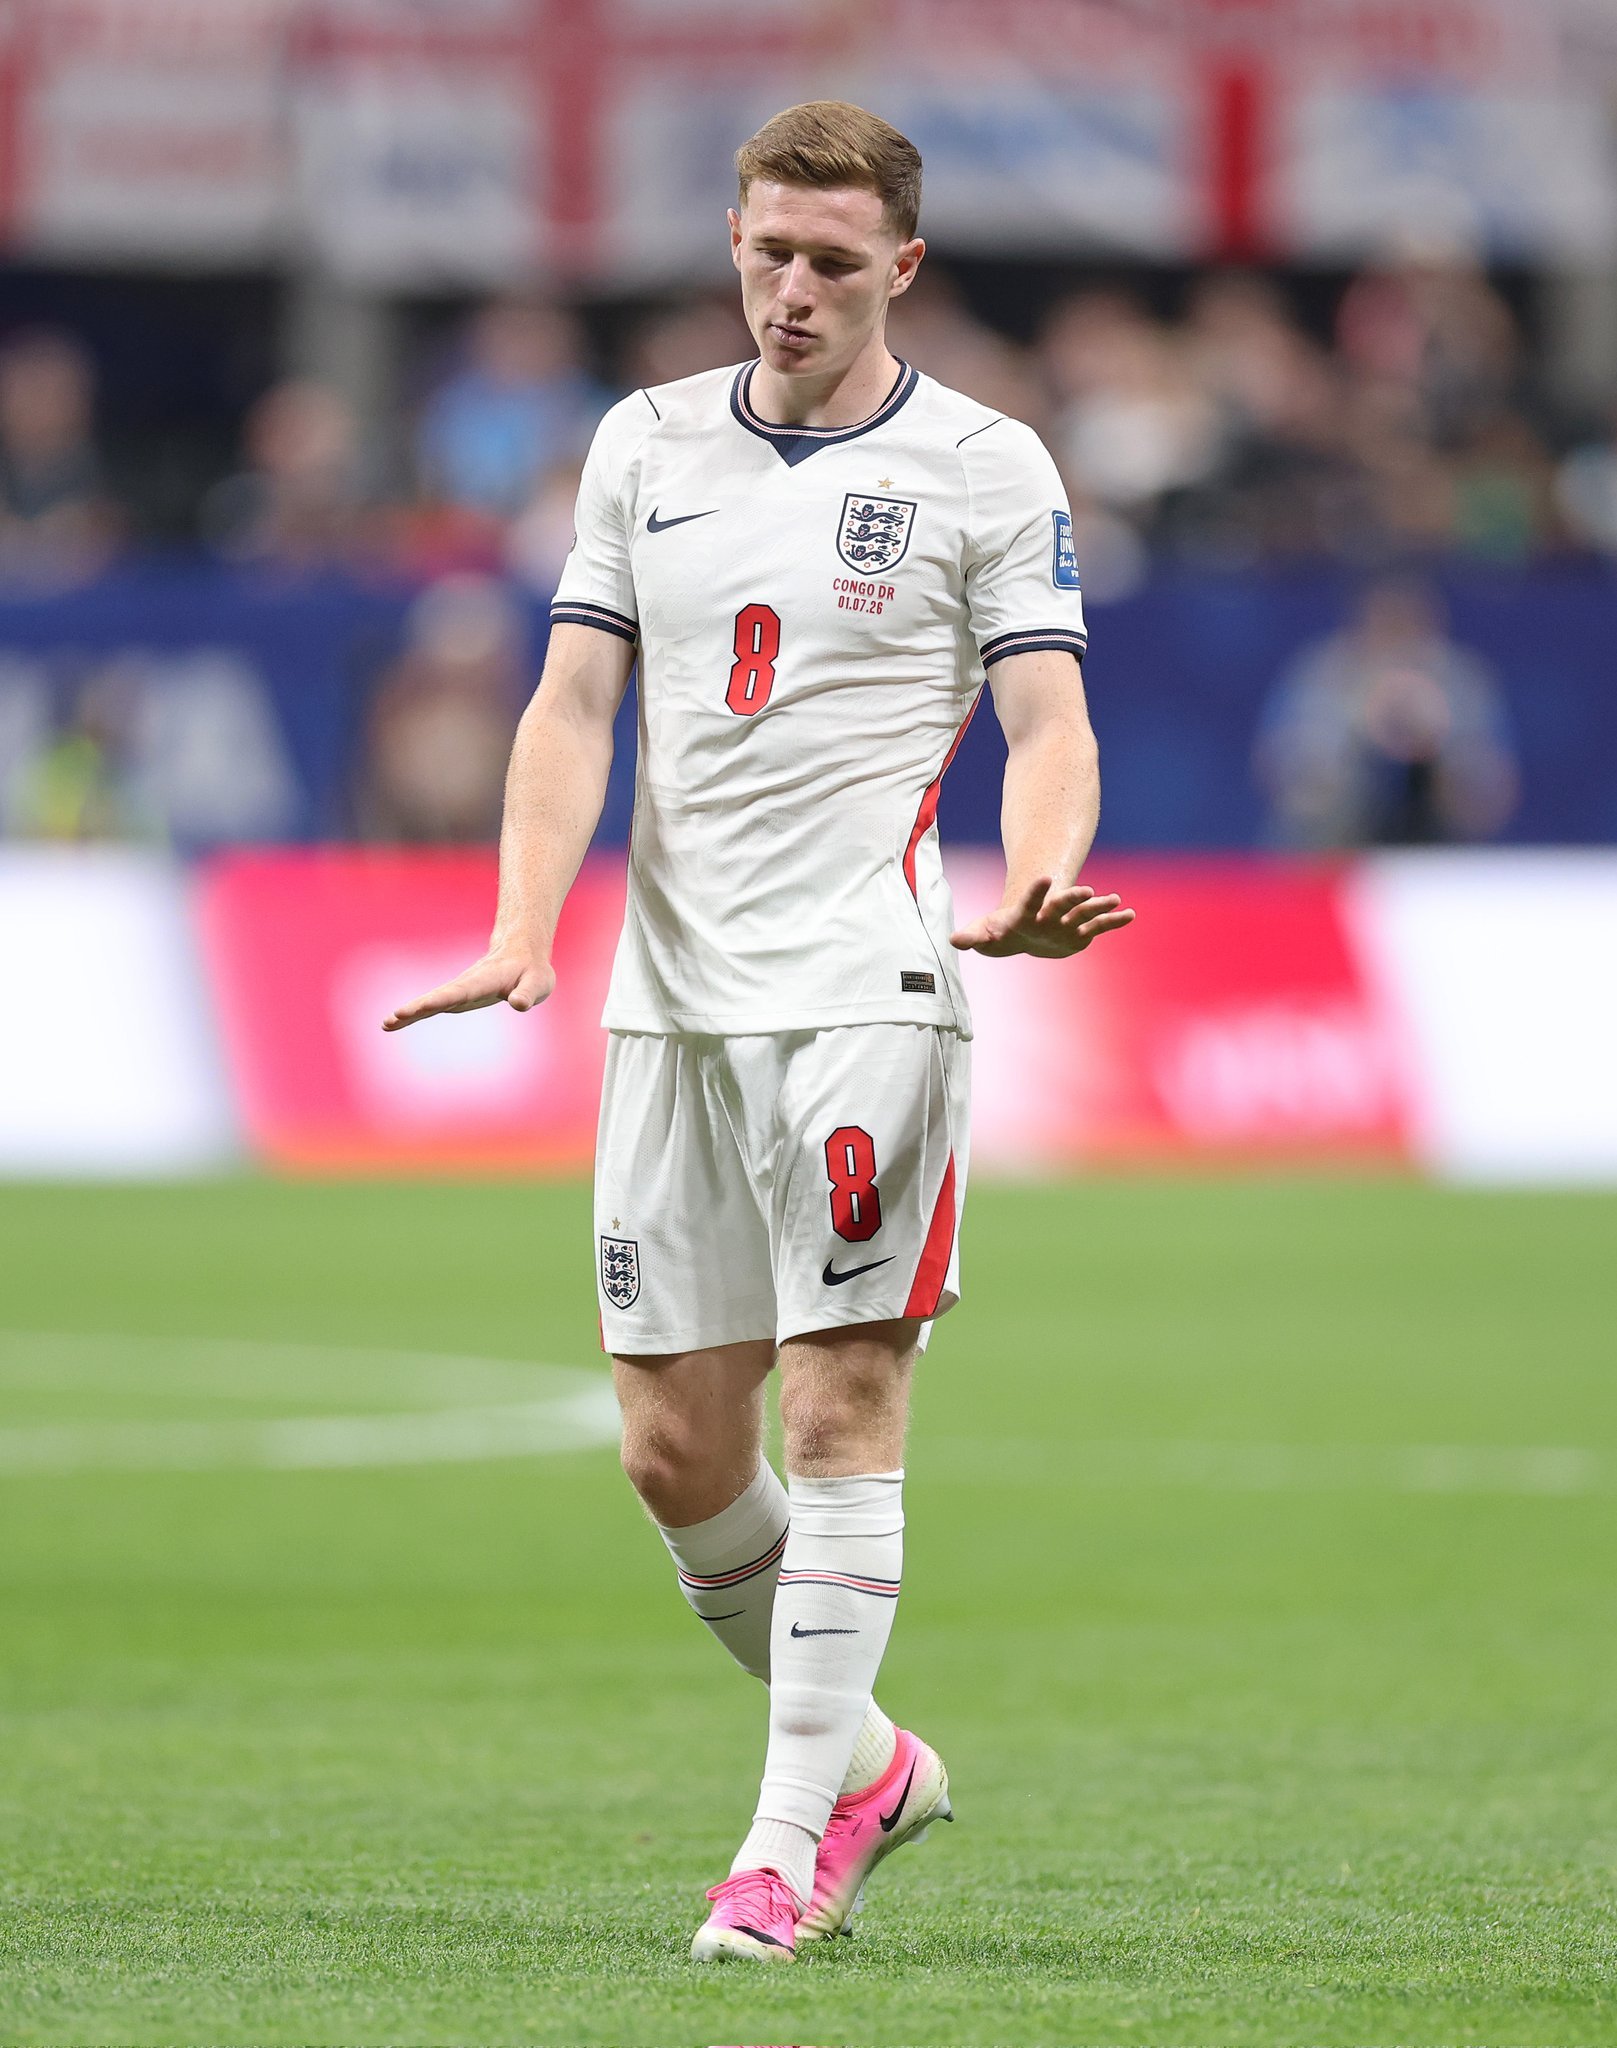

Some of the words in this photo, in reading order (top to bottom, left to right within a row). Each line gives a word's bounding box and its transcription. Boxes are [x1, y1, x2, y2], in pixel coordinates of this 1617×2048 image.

[833, 578, 875, 597] CONGO
[878, 585, 895, 600] DR
[838, 595, 883, 615] 01.07.26
[725, 603, 781, 716] 8
[824, 1126, 882, 1242] 8
